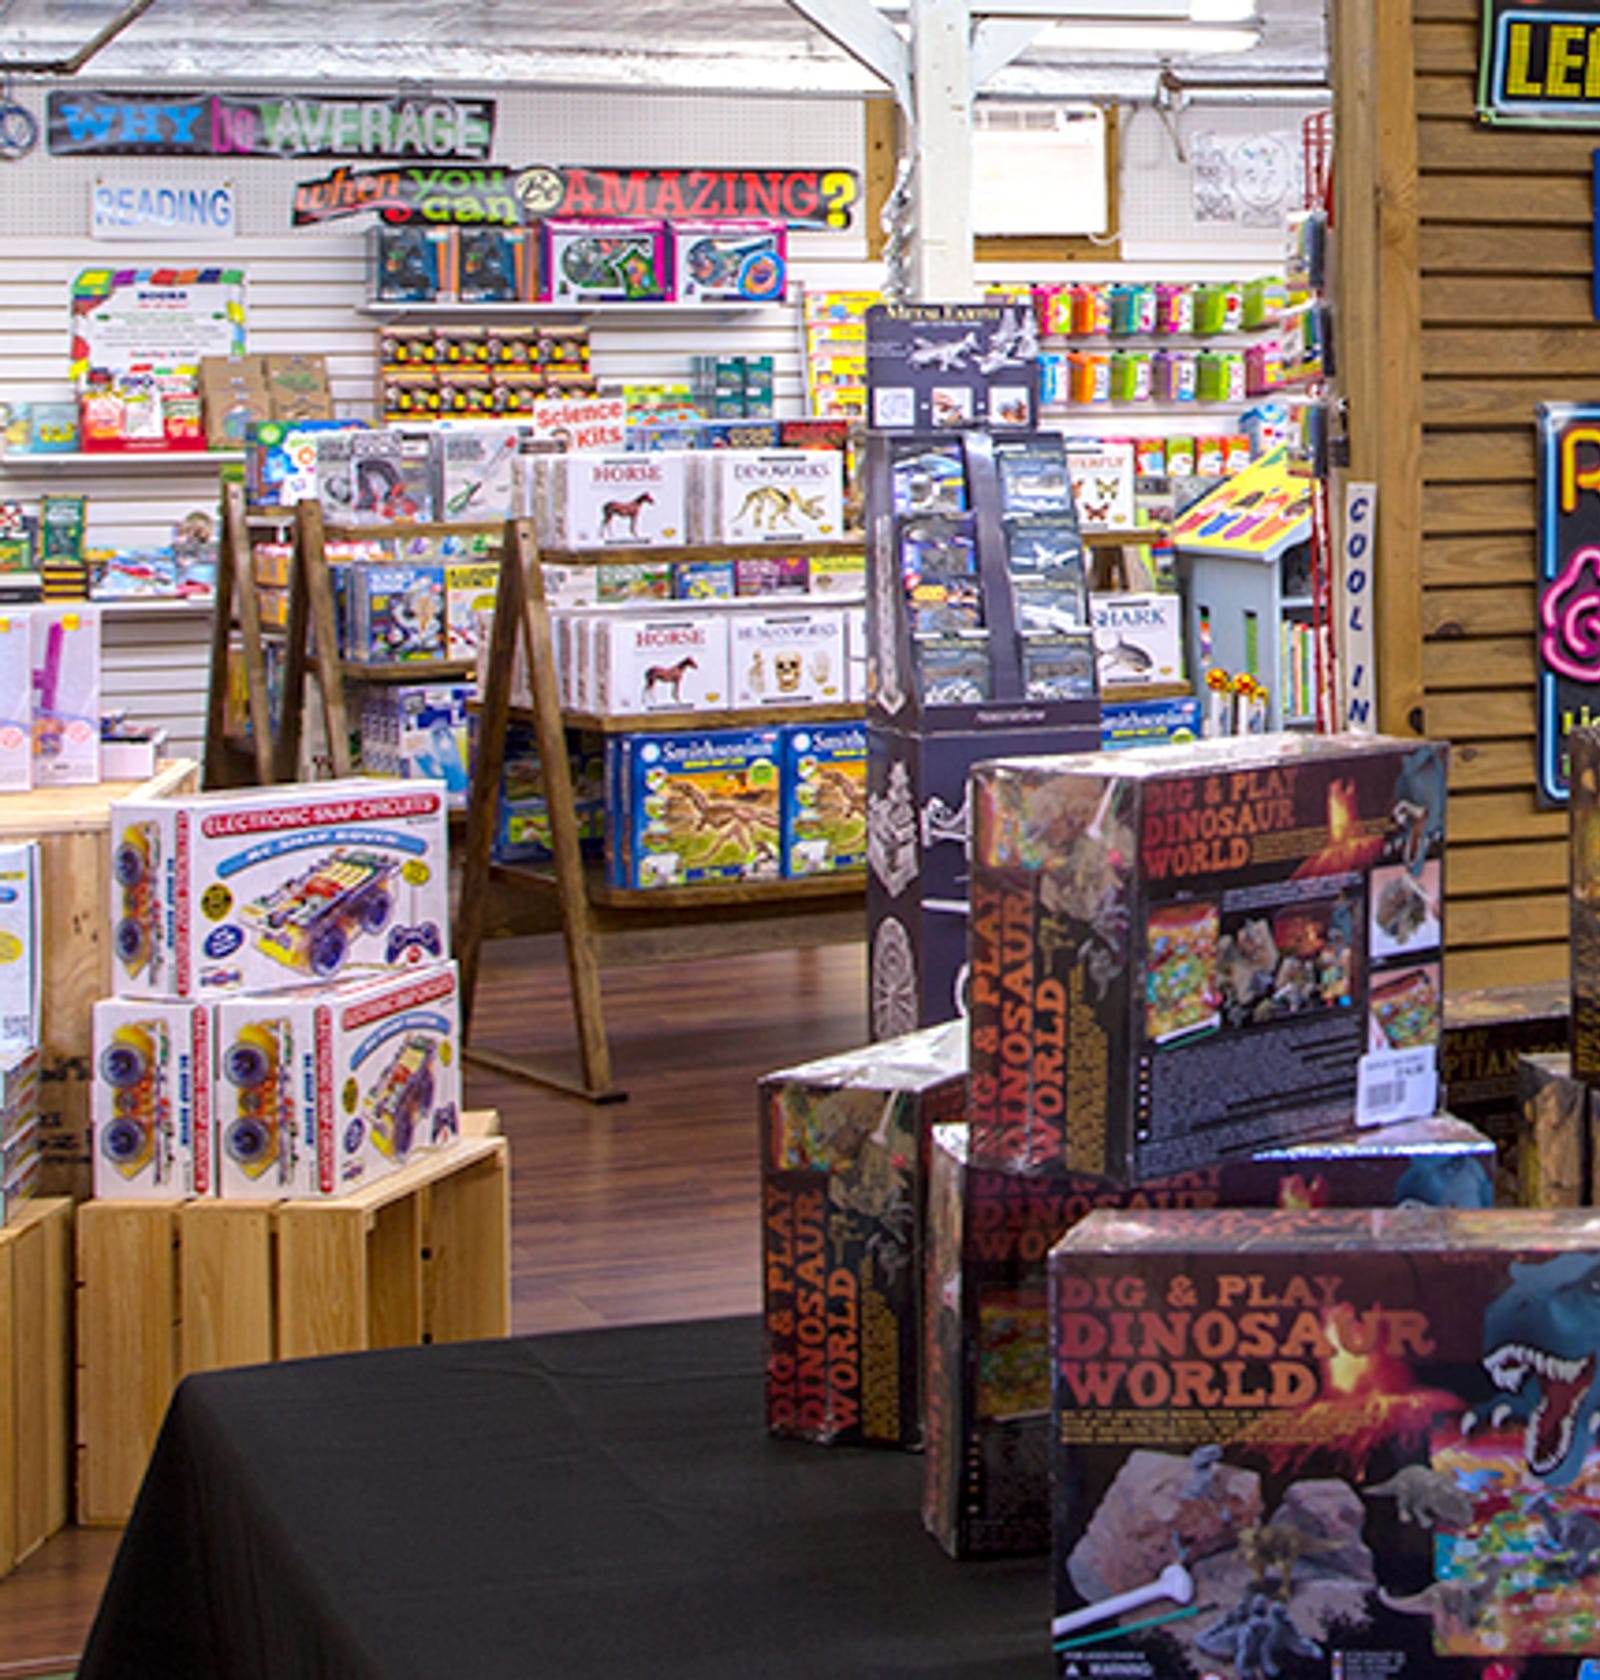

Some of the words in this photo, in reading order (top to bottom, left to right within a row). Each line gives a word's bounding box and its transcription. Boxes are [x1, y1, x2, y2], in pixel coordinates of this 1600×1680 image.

[60, 104, 201, 142] WHY
[211, 95, 253, 153] be
[261, 101, 487, 157] AVERAGE
[95, 187, 233, 227] READING
[295, 172, 398, 212] when
[408, 167, 504, 205] you
[420, 195, 518, 226] can
[537, 402, 623, 428] Science
[576, 426, 623, 448] Kits
[593, 466, 664, 483] HORSE
[636, 631, 705, 648] HORSE
[1144, 780, 1195, 809] DIG
[1205, 776, 1224, 804] &
[1231, 766, 1297, 800] PLAY
[1144, 800, 1295, 844] DINOSAUR
[1144, 837, 1251, 878] WORLD
[973, 882, 998, 1006] PLAY
[1002, 892, 1033, 1160] DINOSAUR
[1035, 978, 1066, 1160] WORLD
[797, 1188, 824, 1430] DINOSAUR
[1061, 1276, 1147, 1309] DIG
[1166, 1274, 1197, 1309] &
[1217, 1274, 1344, 1308] PLAY
[825, 1267, 859, 1430] WORLD
[1060, 1310, 1436, 1359] DINOSAUR
[1060, 1361, 1319, 1408] WORLD
